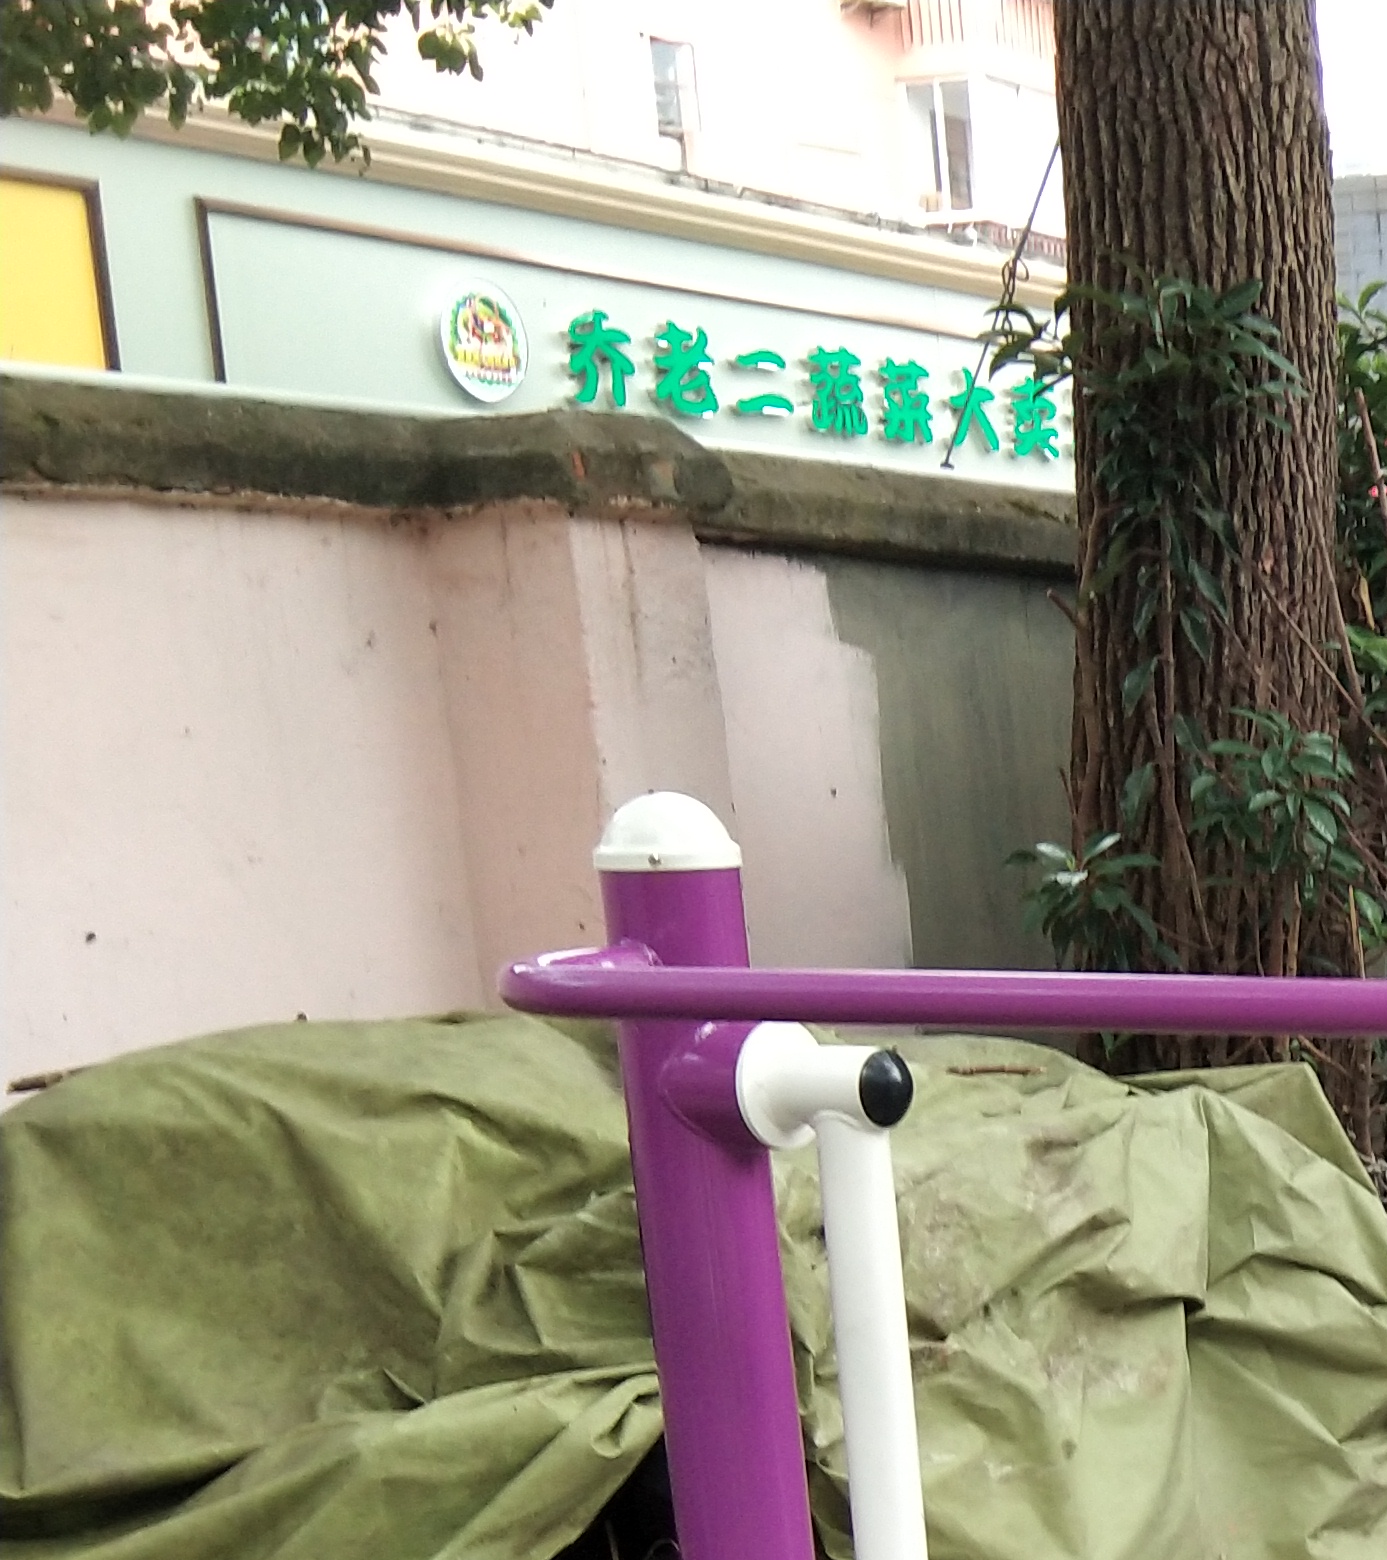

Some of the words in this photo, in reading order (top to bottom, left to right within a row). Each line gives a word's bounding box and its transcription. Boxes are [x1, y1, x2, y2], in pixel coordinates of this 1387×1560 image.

[567, 307, 1061, 461] 乔老二蔬菜大卖
